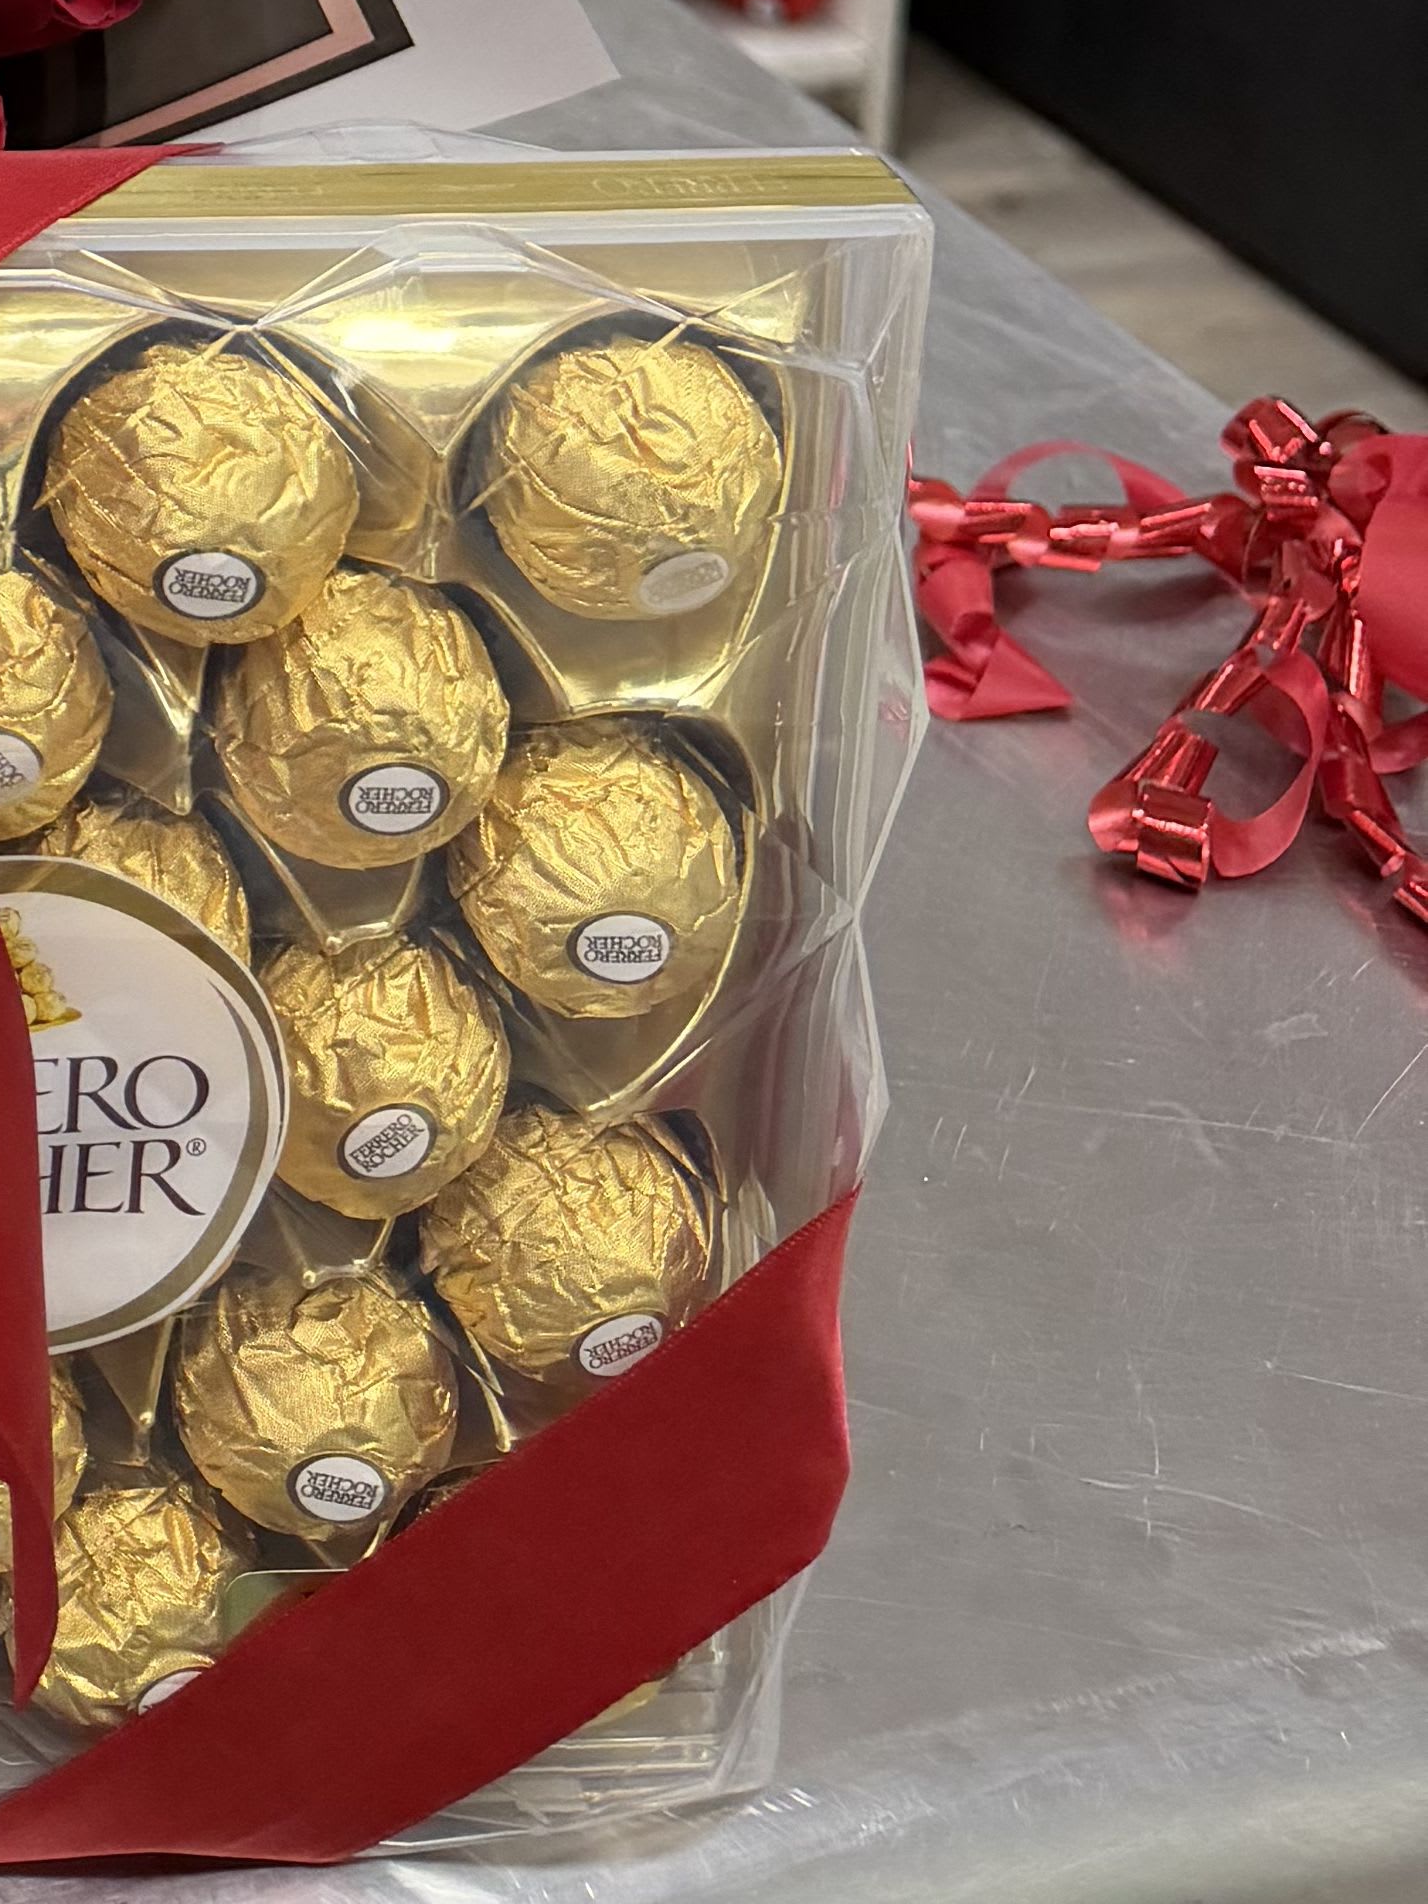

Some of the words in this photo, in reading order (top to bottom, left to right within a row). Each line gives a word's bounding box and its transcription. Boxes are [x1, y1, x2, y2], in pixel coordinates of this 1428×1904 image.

[167, 579, 249, 605] FERRERO
[172, 566, 252, 592] ROCHER
[355, 784, 436, 801] ROCHER
[352, 797, 435, 816] FERRERO
[582, 933, 664, 952] ROCHER
[582, 947, 664, 965] FERRERO
[347, 1112, 414, 1166] FERRERO
[358, 1122, 426, 1175] ROCHER
[582, 1319, 658, 1360] ROCHER
[304, 1469, 380, 1498] ROCHER
[299, 1483, 377, 1511] FERRERO
